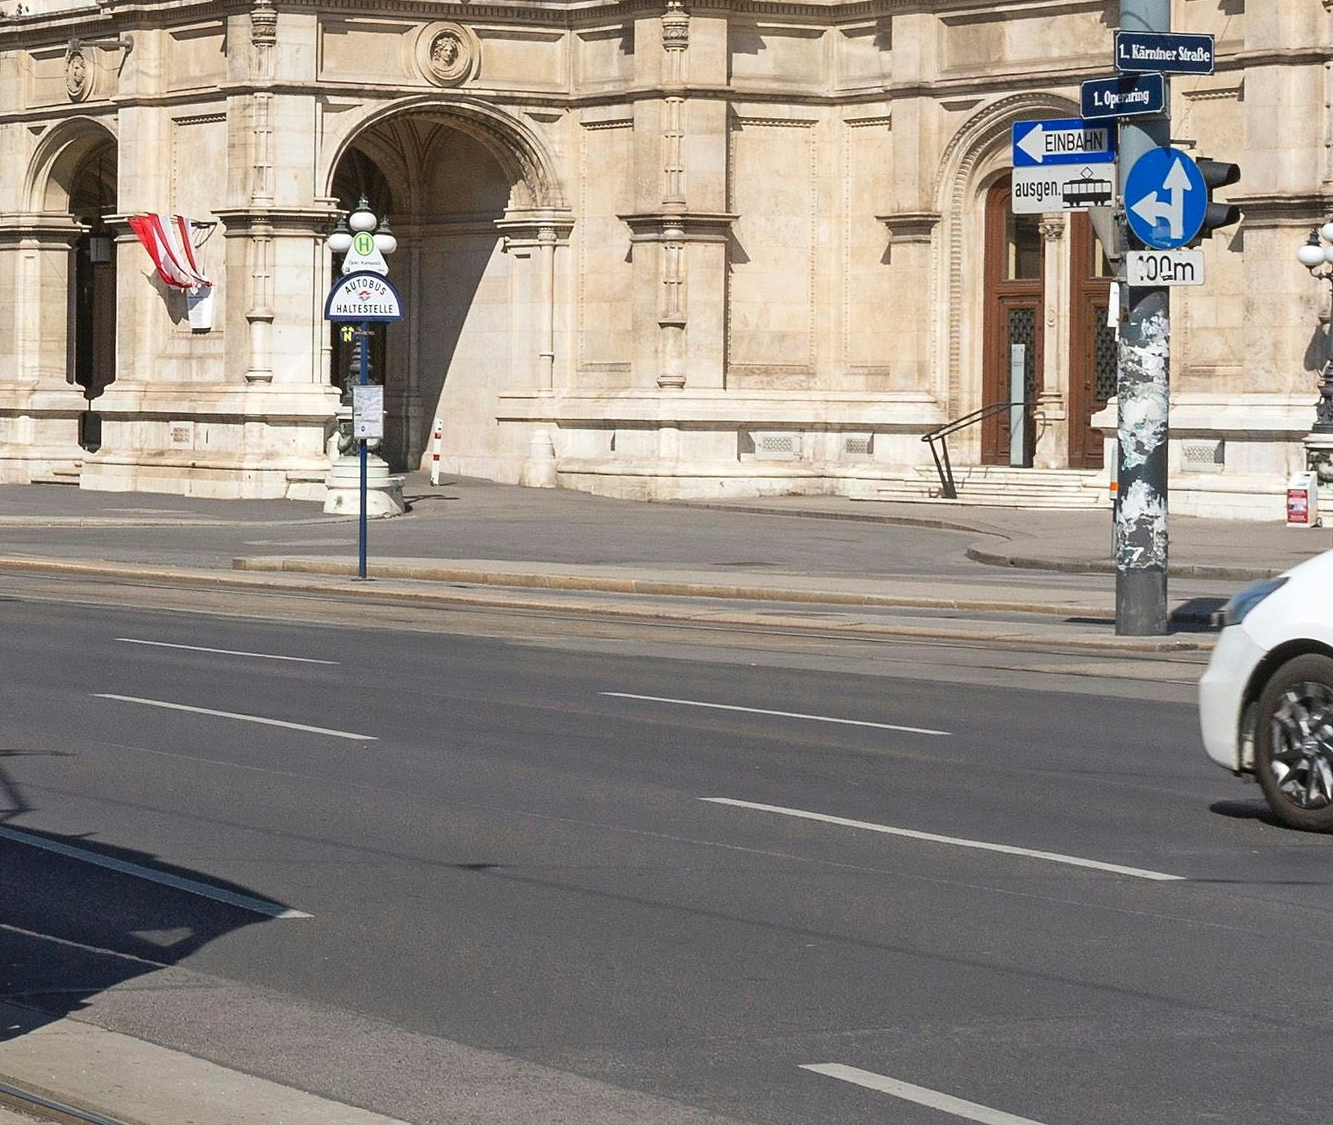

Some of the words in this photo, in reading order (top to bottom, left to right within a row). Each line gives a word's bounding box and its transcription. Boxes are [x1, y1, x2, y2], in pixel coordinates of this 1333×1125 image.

[1131, 44, 1177, 61] Kärntner
[1178, 46, 1211, 62] Straße
[1104, 88, 1149, 109] Opernring
[1045, 132, 1103, 153] EINBAHN
[1015, 180, 1061, 202] ausgen.
[359, 237, 369, 252] H
[1139, 255, 1195, 281] 00m
[344, 278, 387, 295] AUTOBUS
[336, 304, 393, 314] HALTESTELLE
